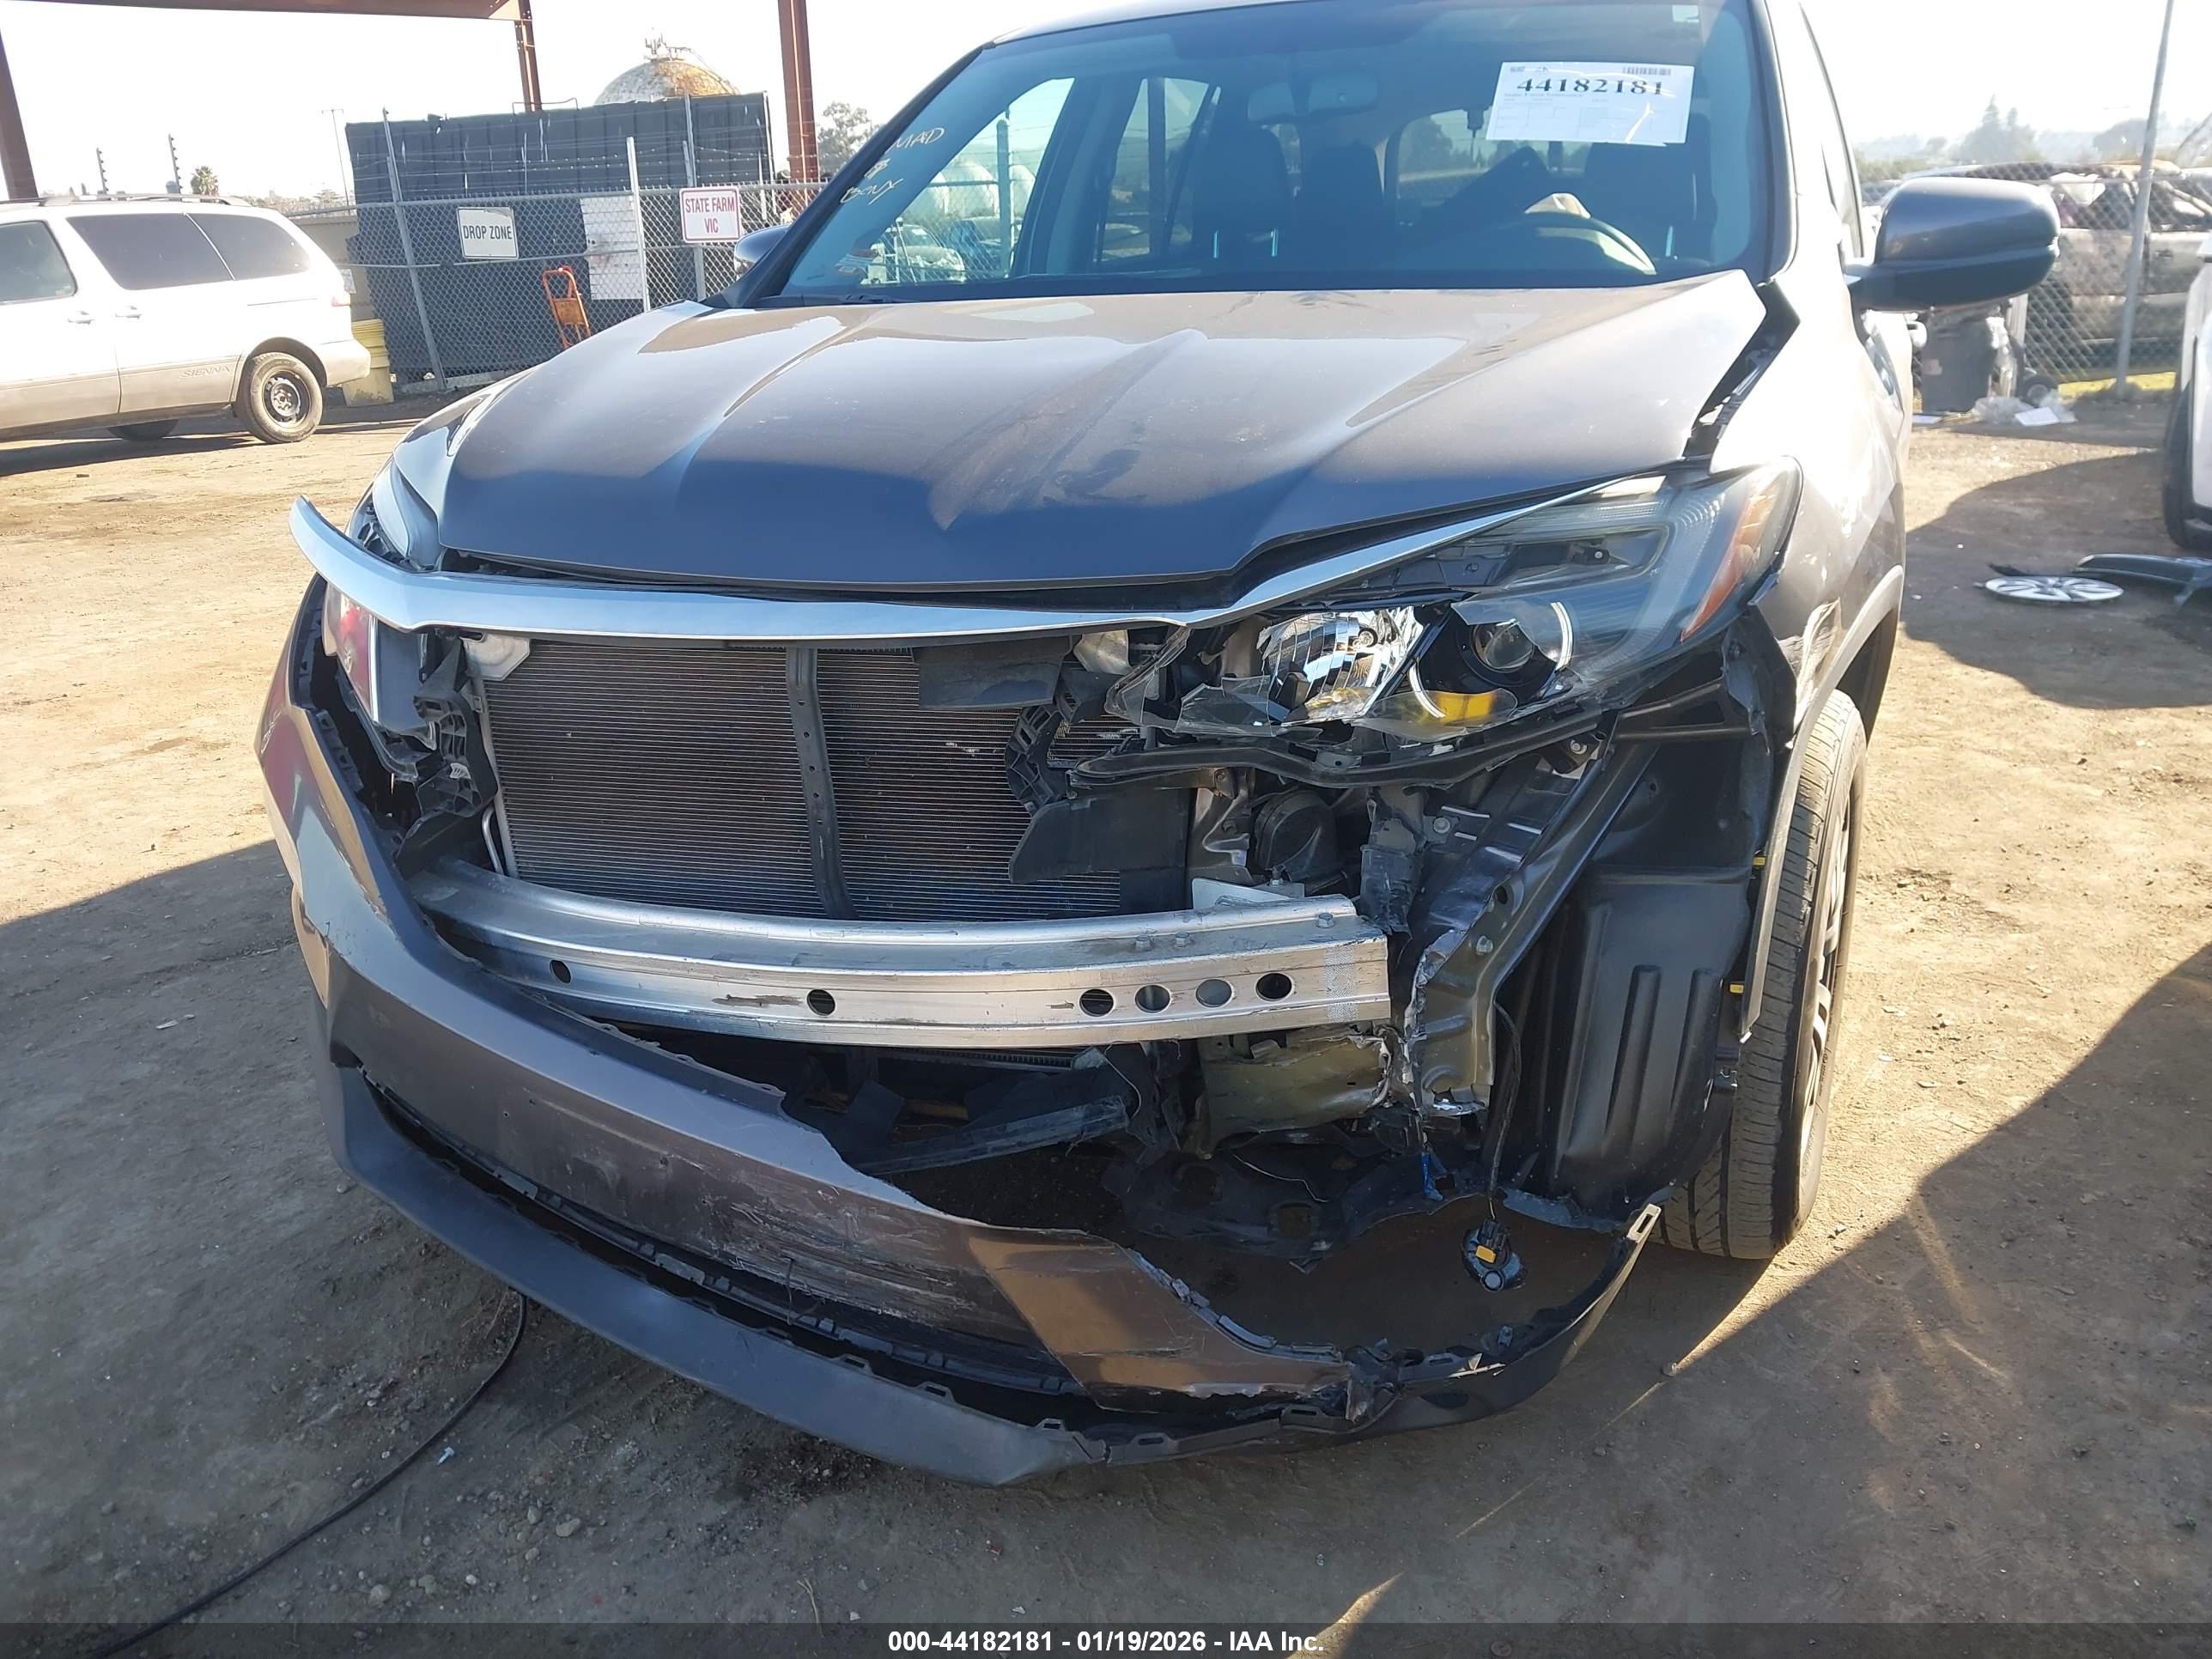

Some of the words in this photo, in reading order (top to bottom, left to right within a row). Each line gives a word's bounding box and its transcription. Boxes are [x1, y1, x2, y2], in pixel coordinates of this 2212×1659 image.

[1516, 78, 1663, 95] 44182181
[685, 198, 710, 213] STATE
[712, 197, 736, 213] FARM
[463, 225, 487, 240] DROP
[489, 225, 513, 240] ZONE
[704, 217, 719, 234] VIC
[179, 365, 231, 378] SIENNA
